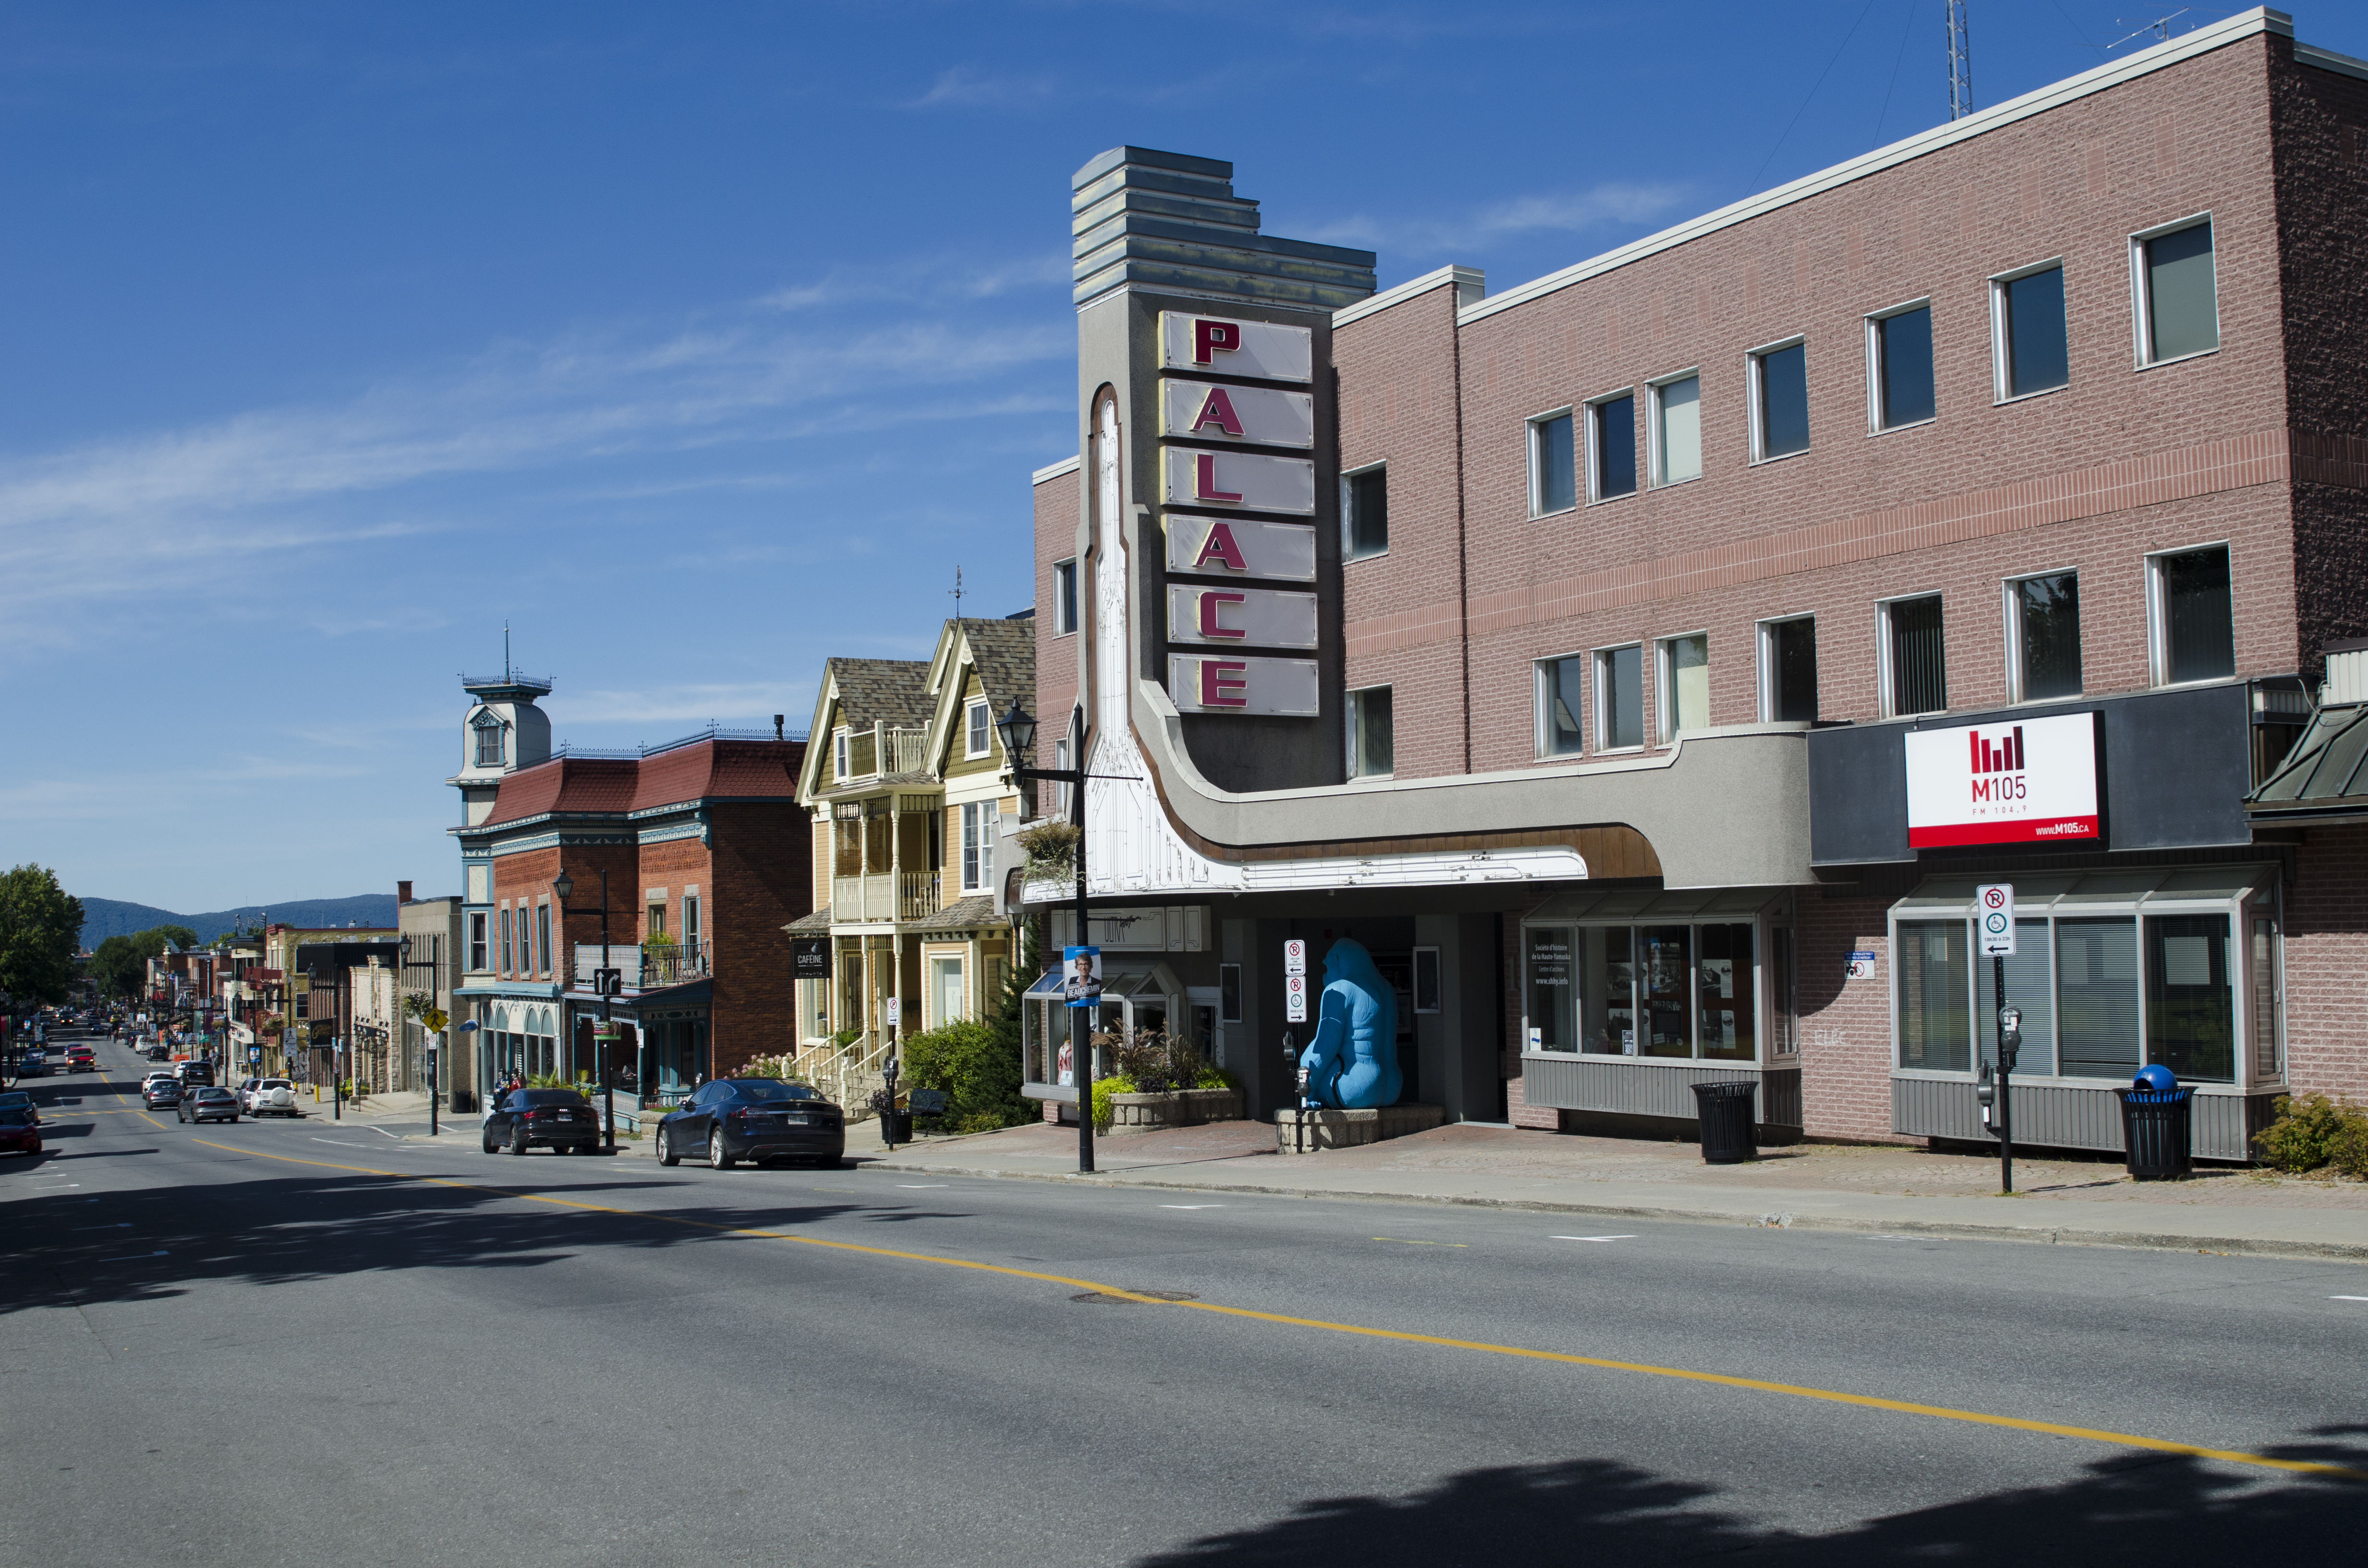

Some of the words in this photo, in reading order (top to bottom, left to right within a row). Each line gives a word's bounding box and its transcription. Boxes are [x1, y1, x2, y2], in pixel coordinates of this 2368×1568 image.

[1190, 318, 1249, 709] PALACE
[1972, 775, 2026, 803] M105
[1995, 805, 2027, 814] 104,9
[798, 954, 823, 964] CAFÉINE
[1536, 977, 1568, 986] www.shhy.info
[1067, 984, 1100, 997] BEAUCHEMIN
